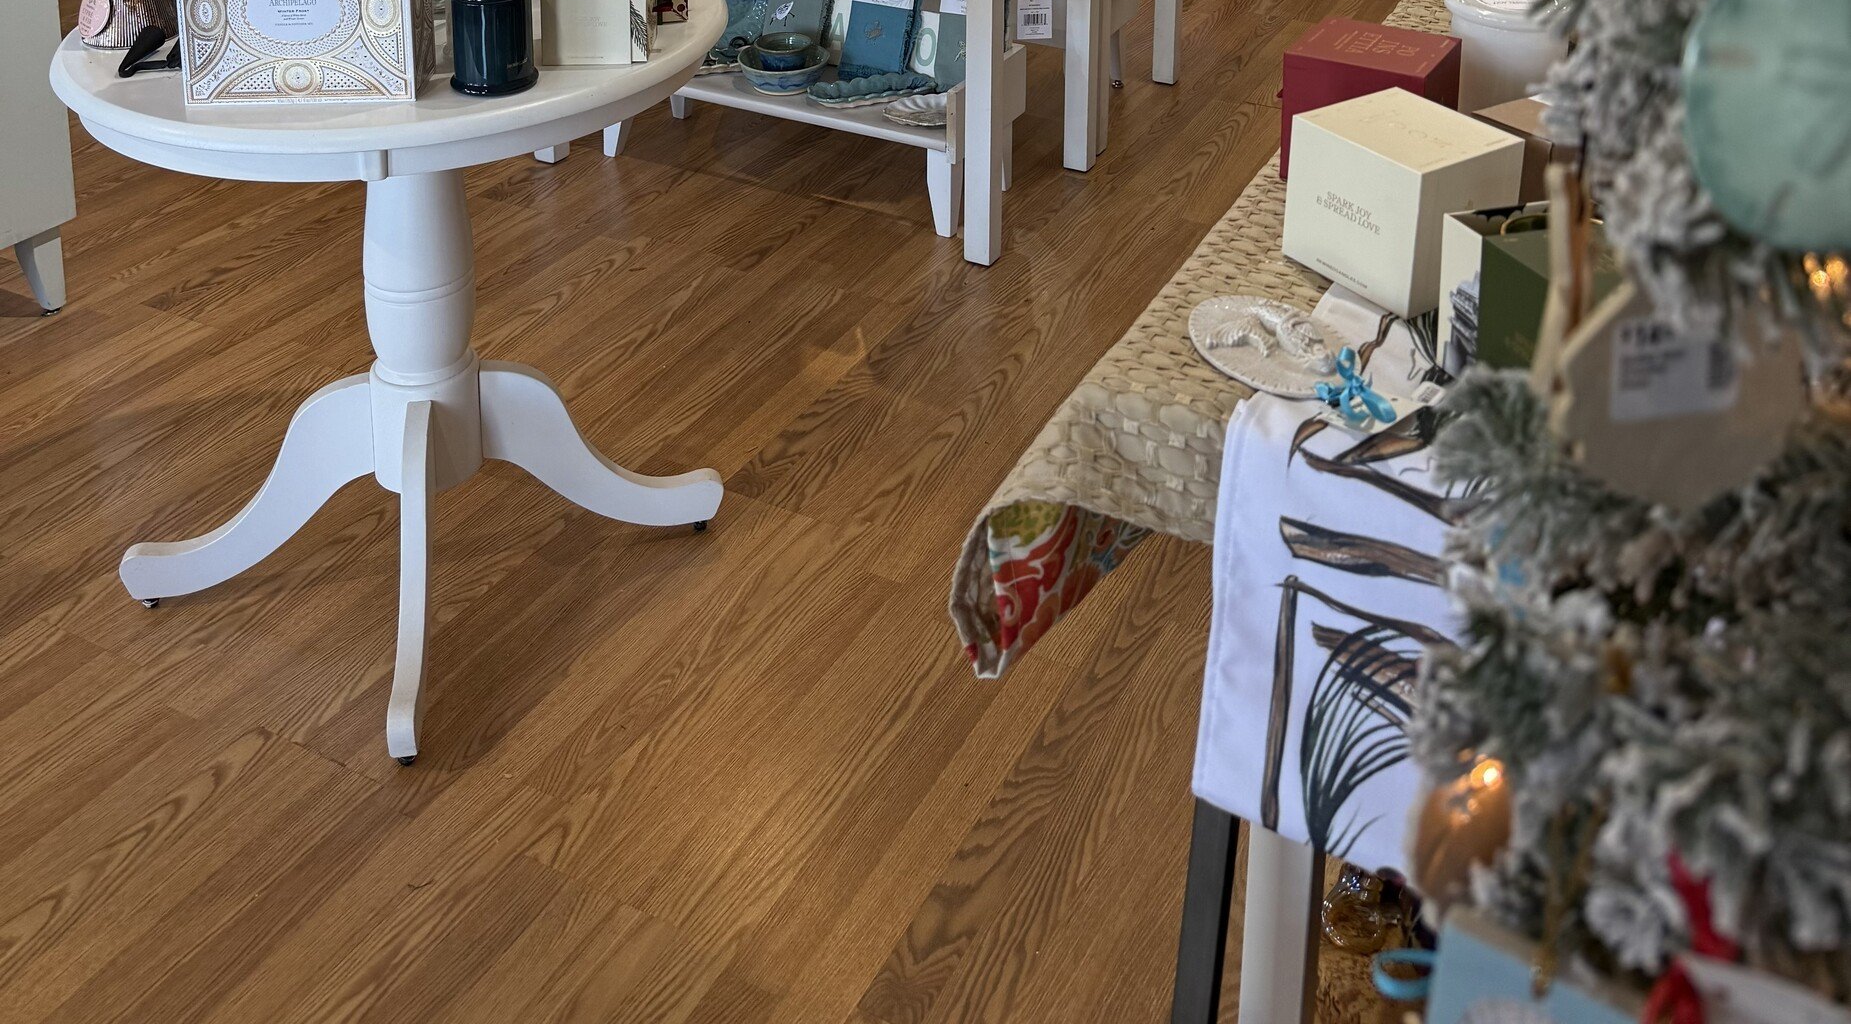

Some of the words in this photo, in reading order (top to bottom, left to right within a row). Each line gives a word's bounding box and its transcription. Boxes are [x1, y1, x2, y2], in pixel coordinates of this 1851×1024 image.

[1323, 198, 1357, 223] SPREAD
[1358, 216, 1381, 236] LOVE
[1327, 190, 1355, 213] SPARK
[1355, 205, 1372, 220] JOY
